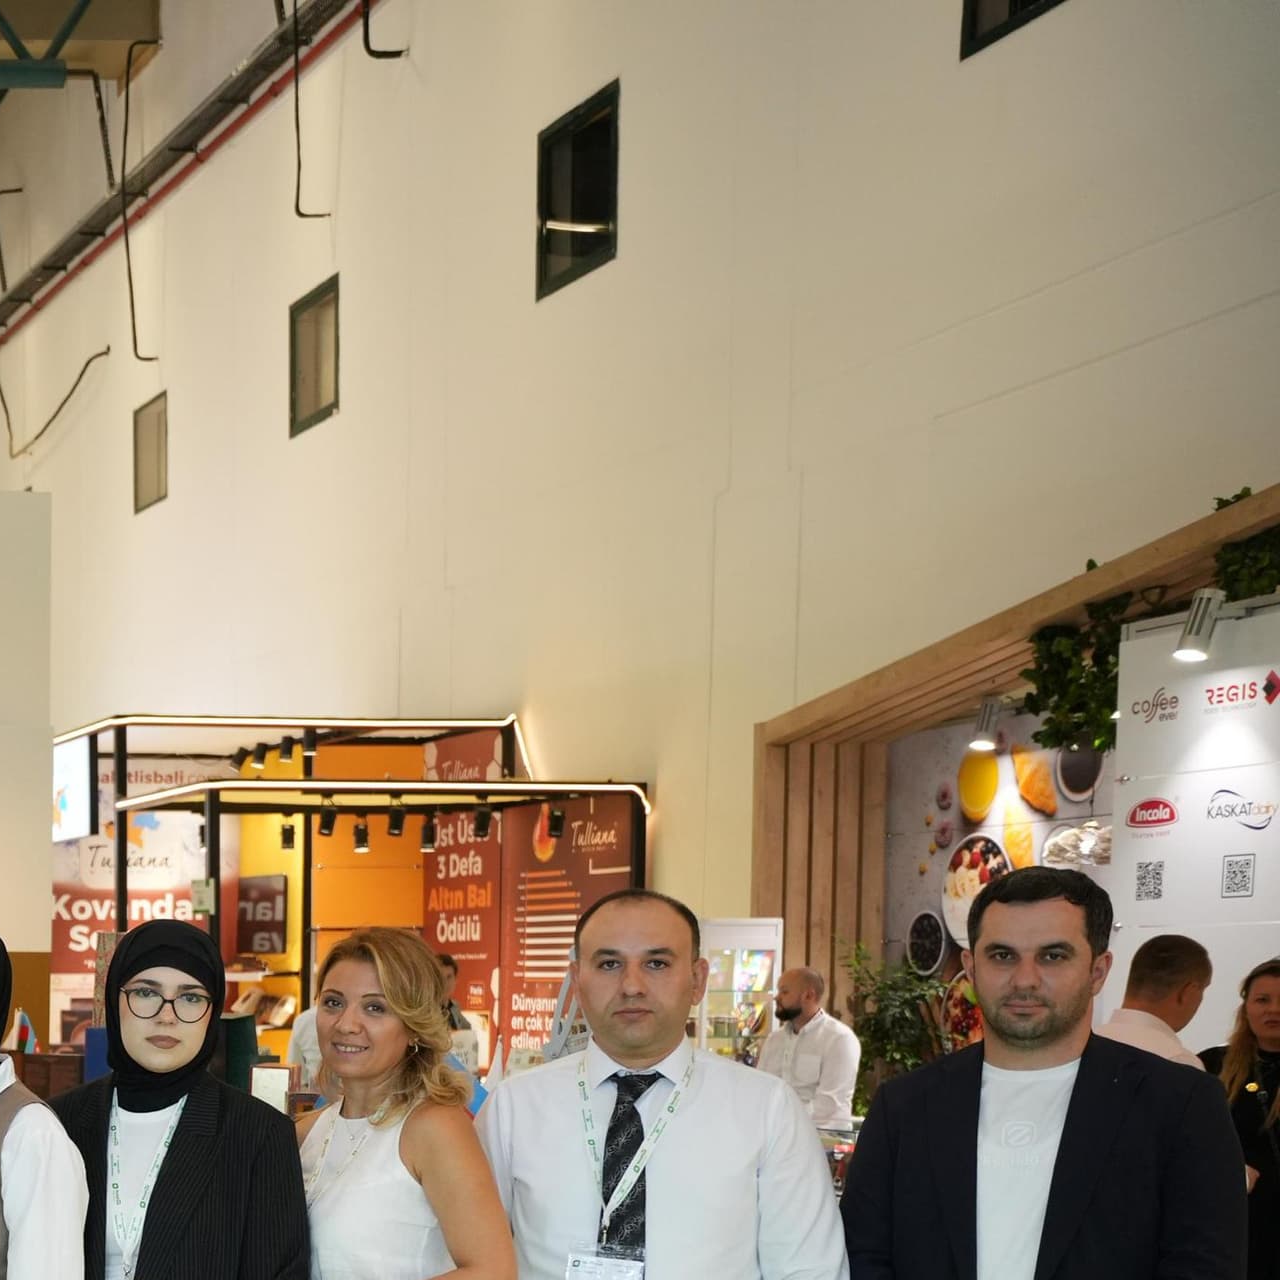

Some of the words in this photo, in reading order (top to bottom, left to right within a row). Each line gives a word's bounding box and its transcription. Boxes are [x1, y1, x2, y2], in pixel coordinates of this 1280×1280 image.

[1205, 681, 1258, 705] REGIS
[1135, 807, 1171, 822] Incola
[571, 821, 618, 847] Tulliana
[436, 854, 446, 880] 3
[449, 850, 483, 877] Defa
[466, 882, 492, 908] Bal
[436, 913, 481, 944] Ödülü
[511, 1016, 524, 1030] en
[510, 1031, 541, 1049] edilen
